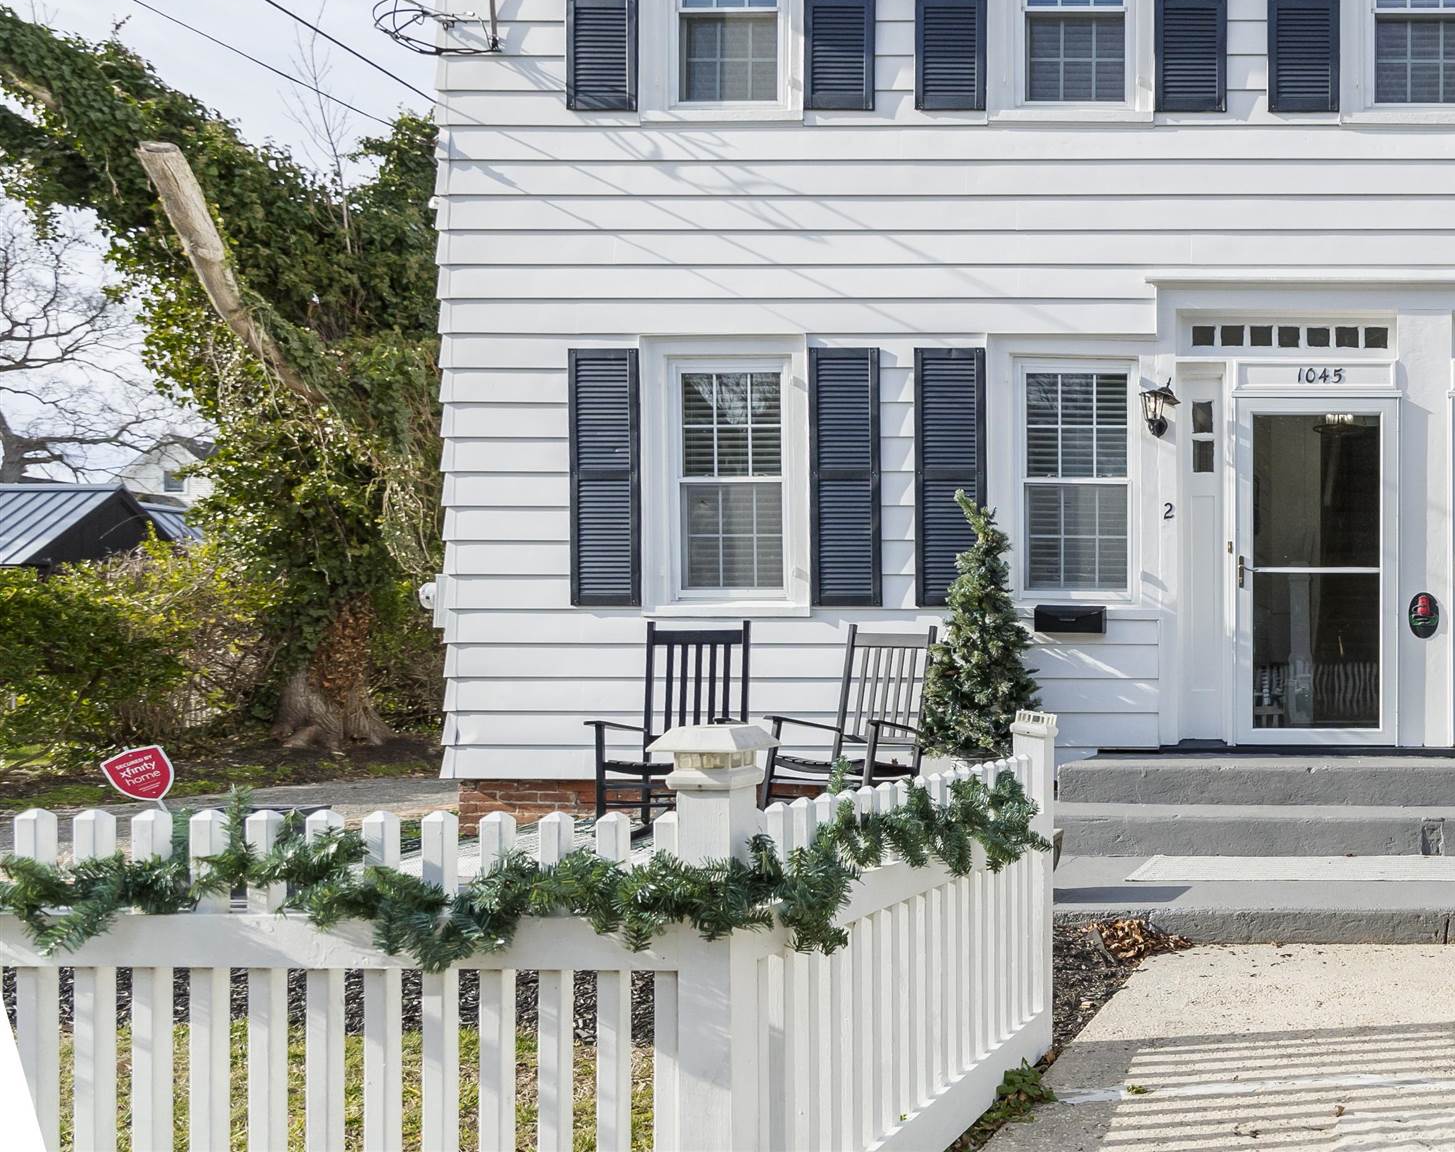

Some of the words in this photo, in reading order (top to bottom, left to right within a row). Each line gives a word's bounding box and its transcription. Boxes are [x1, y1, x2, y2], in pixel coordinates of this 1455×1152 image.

[1297, 367, 1343, 384] 1045
[1163, 502, 1175, 520] 2
[120, 761, 156, 778] xfinity
[125, 770, 161, 786] home
